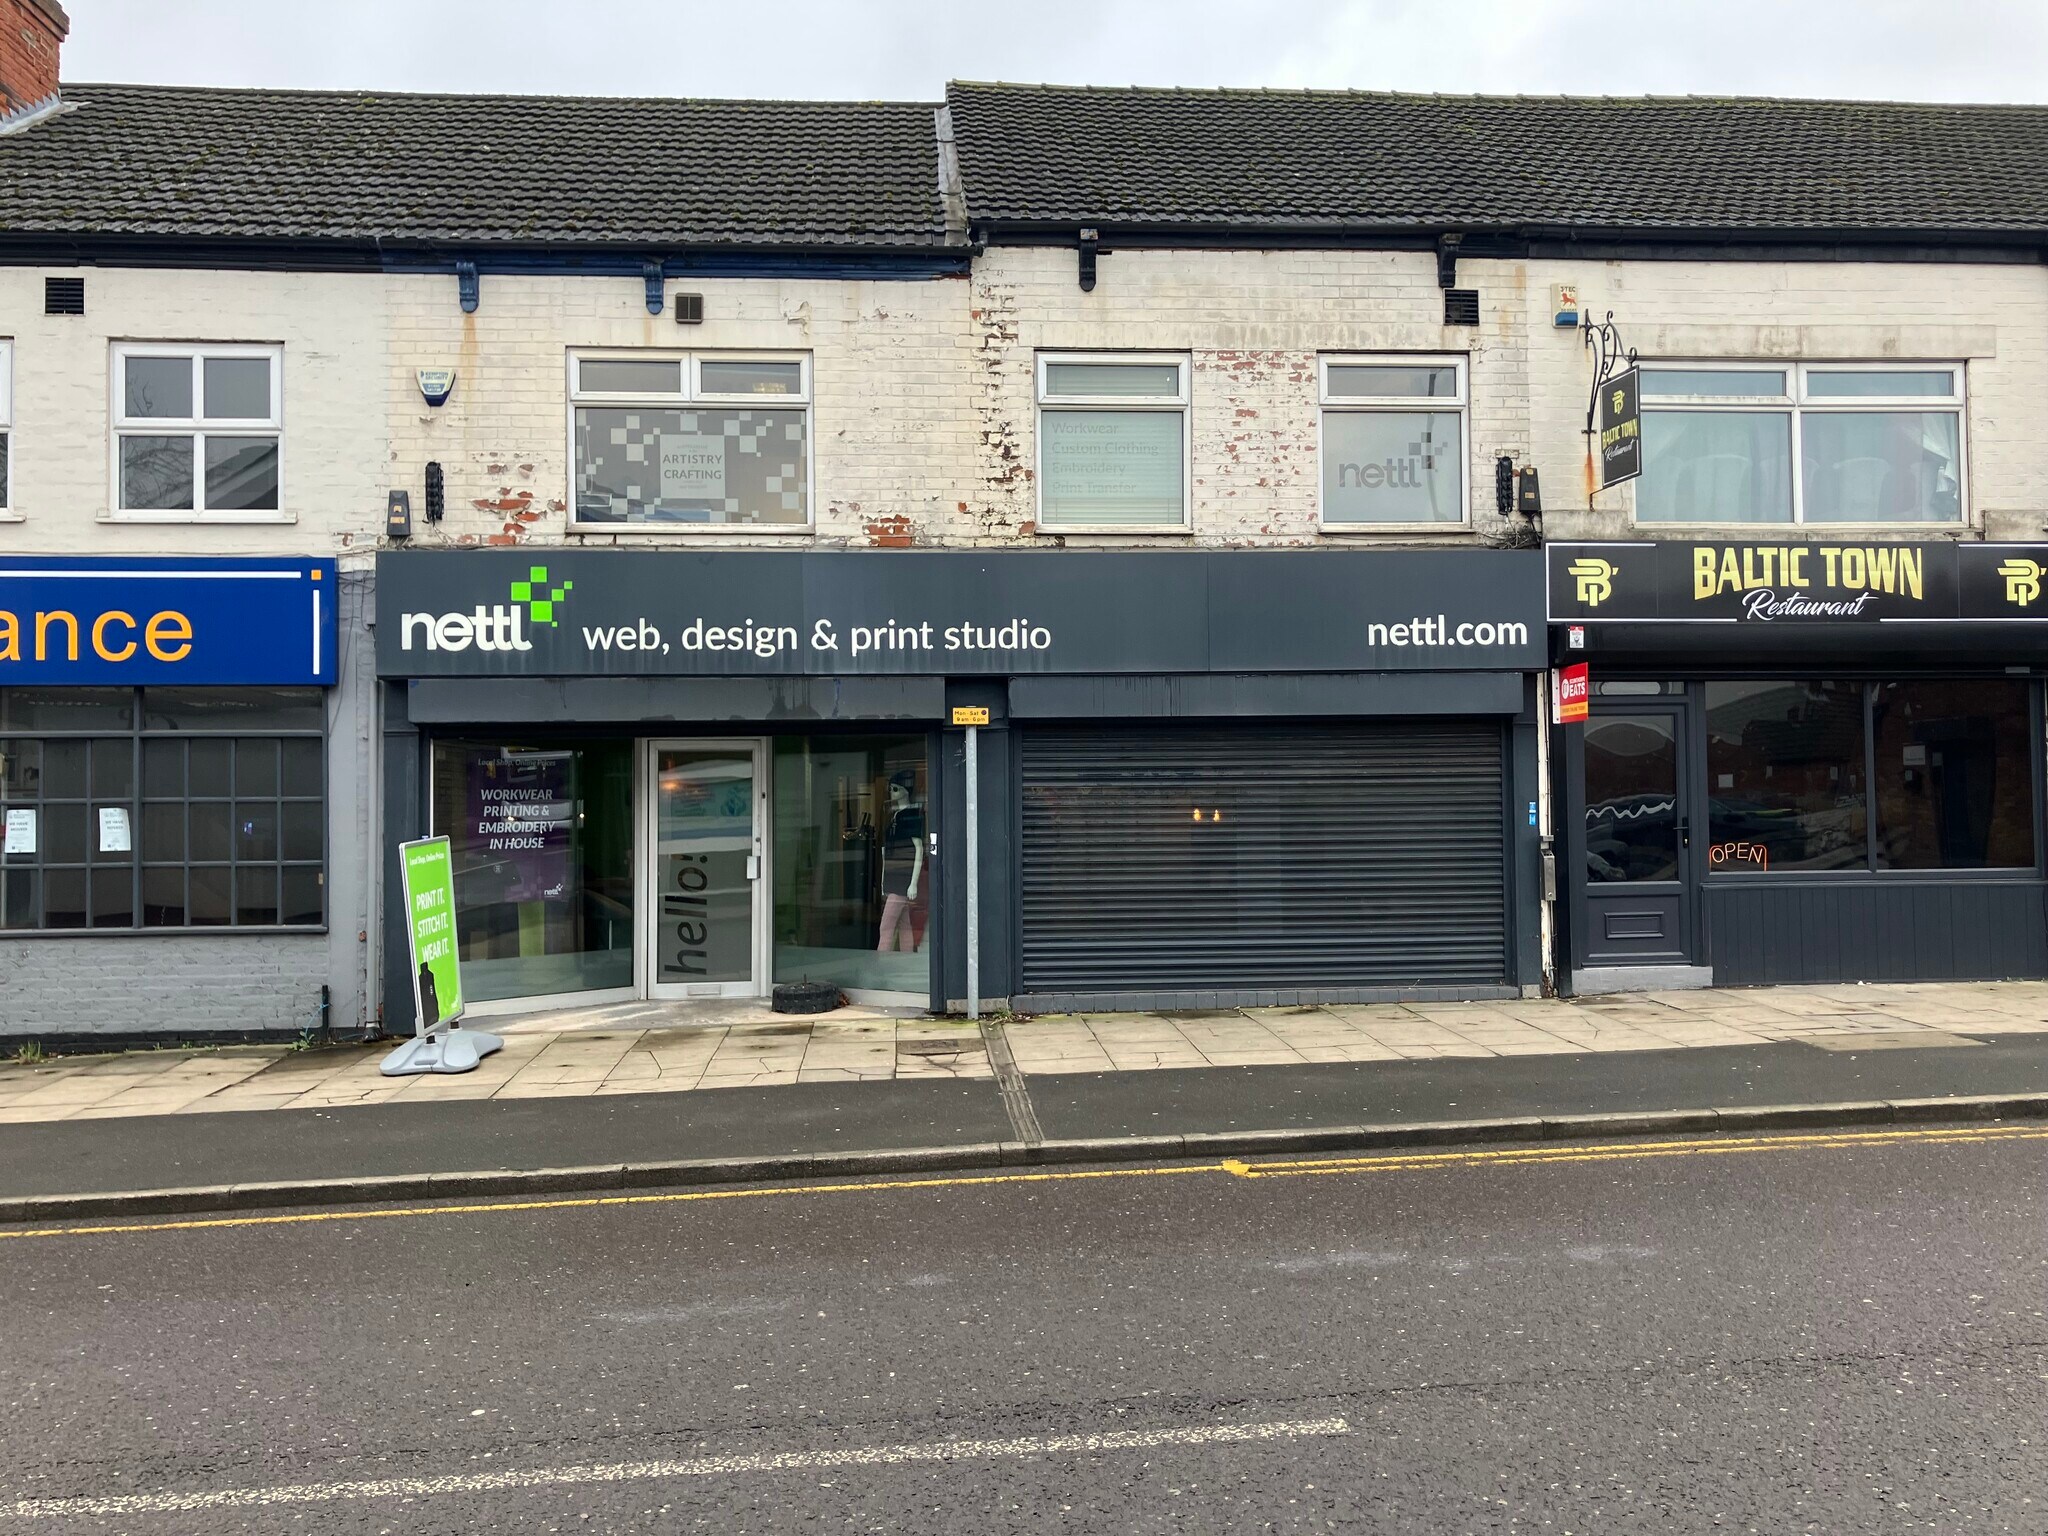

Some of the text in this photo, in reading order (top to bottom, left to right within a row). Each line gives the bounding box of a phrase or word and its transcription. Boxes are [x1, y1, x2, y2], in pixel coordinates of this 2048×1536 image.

[1050, 422, 1119, 434] Workwear
[1602, 417, 1638, 451] BALTIC TOWN
[1051, 441, 1160, 456] Custom Clothing
[662, 454, 723, 464] ARTISTRY
[663, 469, 722, 479] CRAFTING
[1052, 462, 1127, 476] Embroidery
[1338, 458, 1422, 489] nettl
[1052, 481, 1137, 493] Print Transfer
[1693, 547, 1923, 601] BALTIC TOWN
[1741, 588, 1879, 621] Restaurant
[401, 604, 533, 651] nettl
[1368, 614, 1528, 646] nettl.com
[581, 617, 1051, 657] web, design & print studio
[1569, 682, 1585, 697] EATS
[478, 758, 496, 767] Local
[480, 789, 553, 801] WORKWEAR
[483, 805, 549, 817] PRINTING &
[478, 821, 556, 833] EMBROIDERY
[489, 837, 545, 850] IN HOUSE
[1711, 842, 1763, 864] OPEN
[416, 887, 445, 912] PRINT IT.
[664, 853, 708, 975] hello!
[417, 911, 449, 938] STITCH IT.
[421, 937, 450, 962] WEAR IT.
